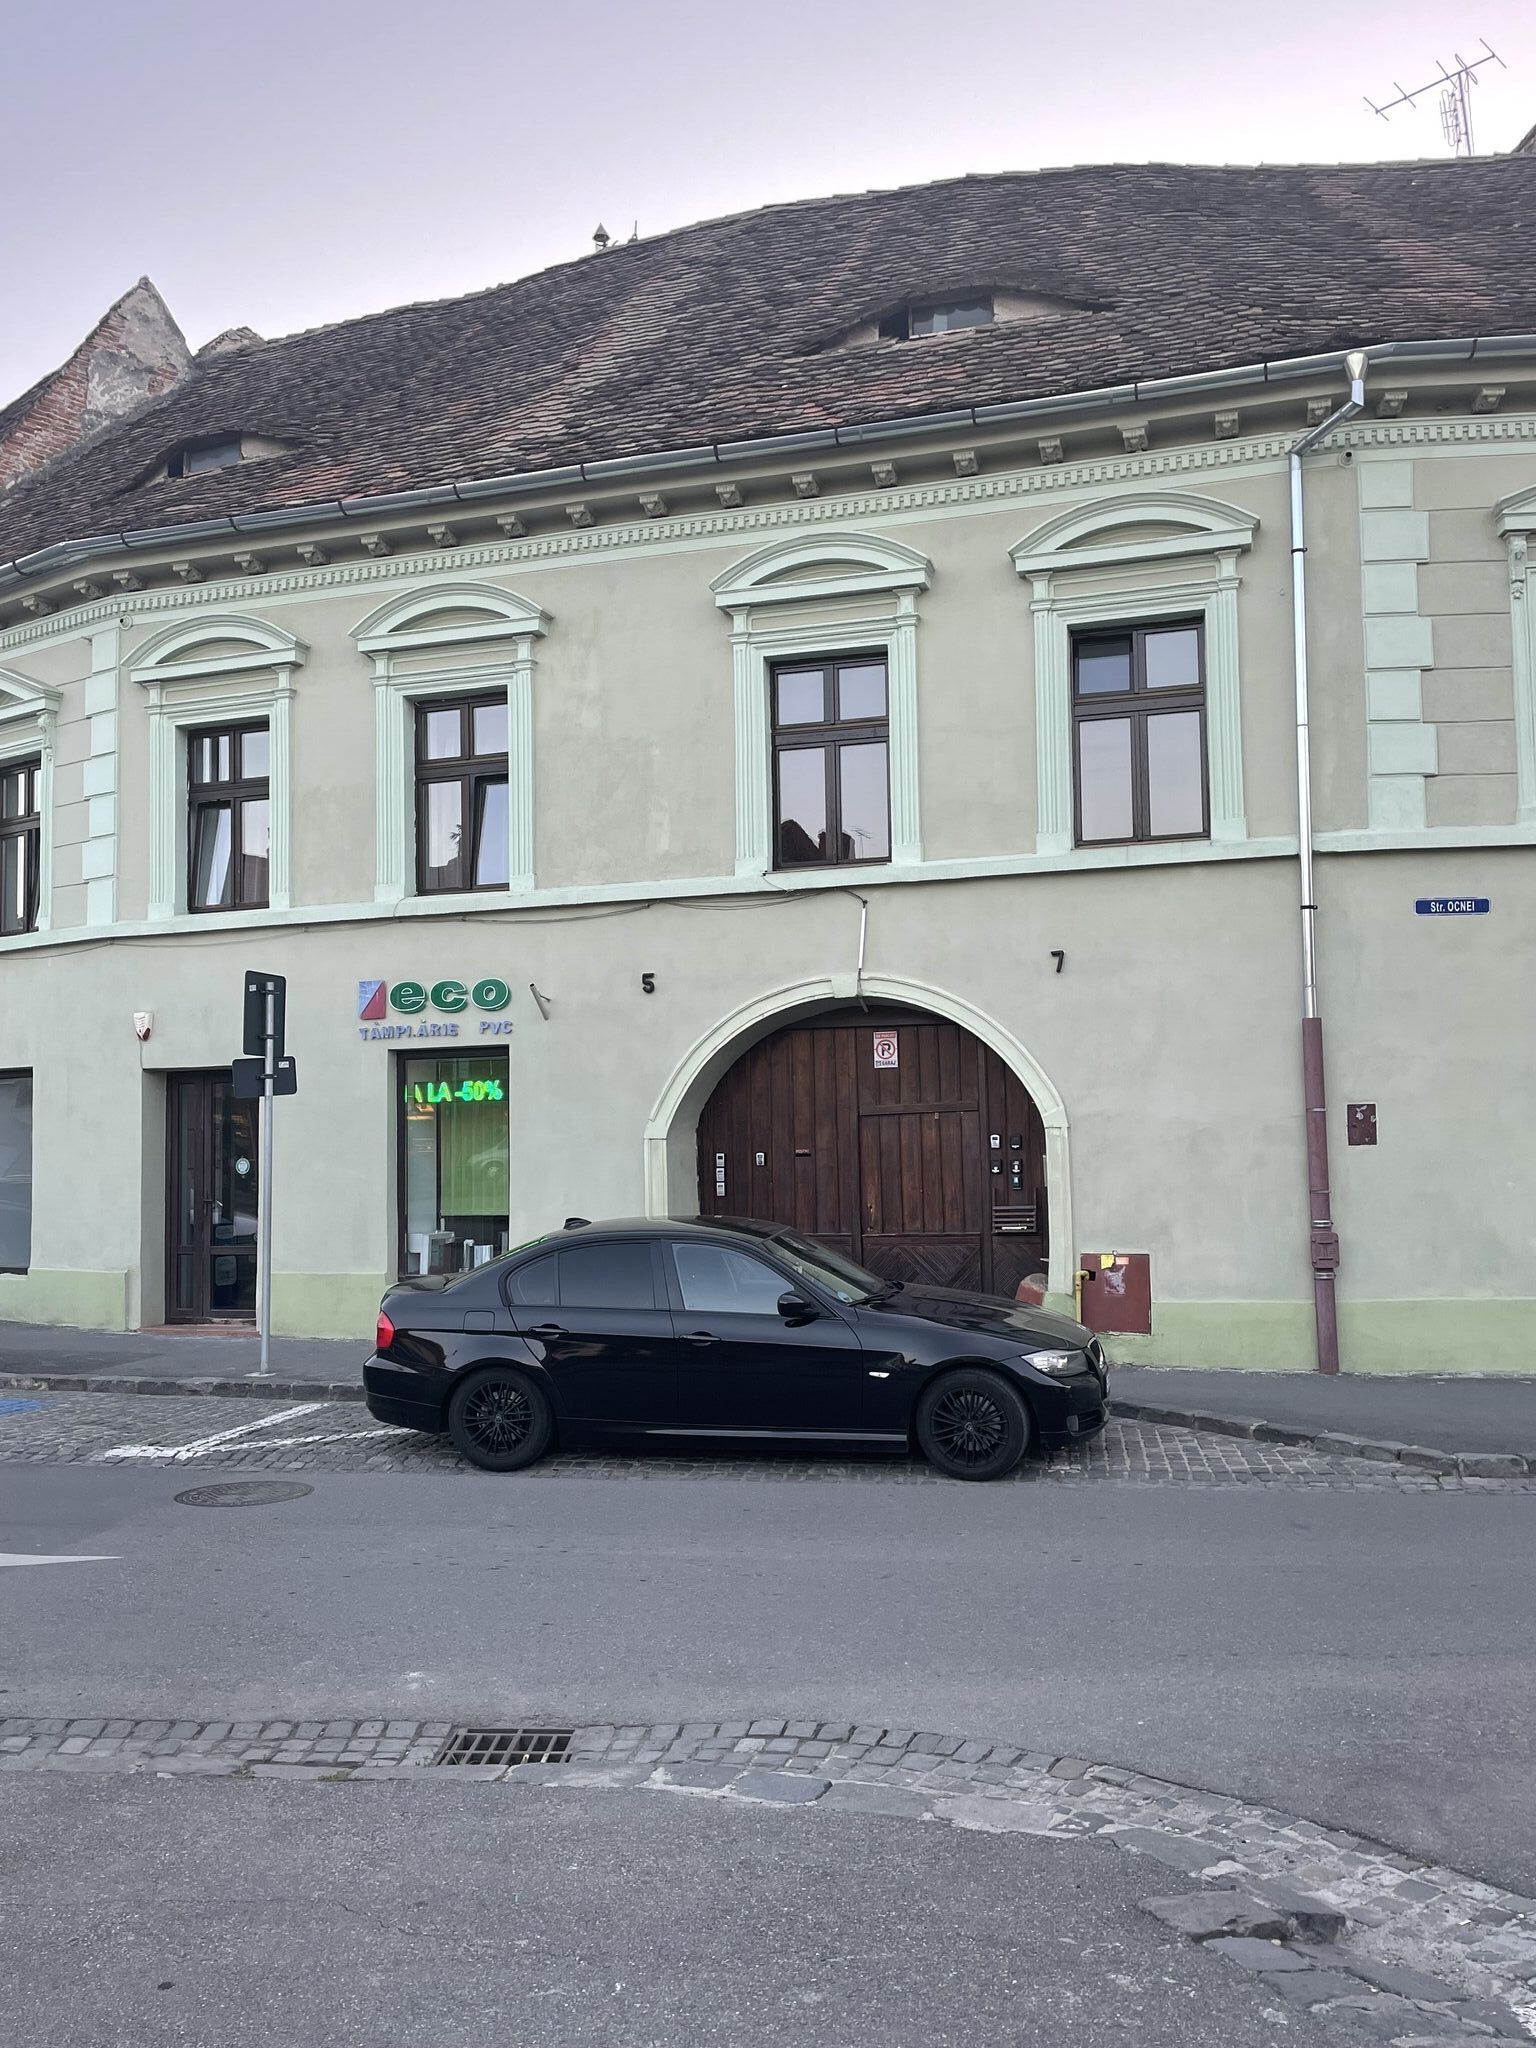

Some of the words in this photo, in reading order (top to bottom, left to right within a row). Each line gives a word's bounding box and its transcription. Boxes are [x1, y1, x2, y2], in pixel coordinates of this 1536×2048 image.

[1430, 901, 1445, 912] Str.
[1447, 900, 1475, 912] OCNEI
[1050, 950, 1065, 973] 7
[641, 972, 655, 994] 5
[389, 978, 512, 1013] eco
[479, 1020, 513, 1035] PVC
[427, 1081, 452, 1103] LA
[454, 1079, 503, 1102] -50%
